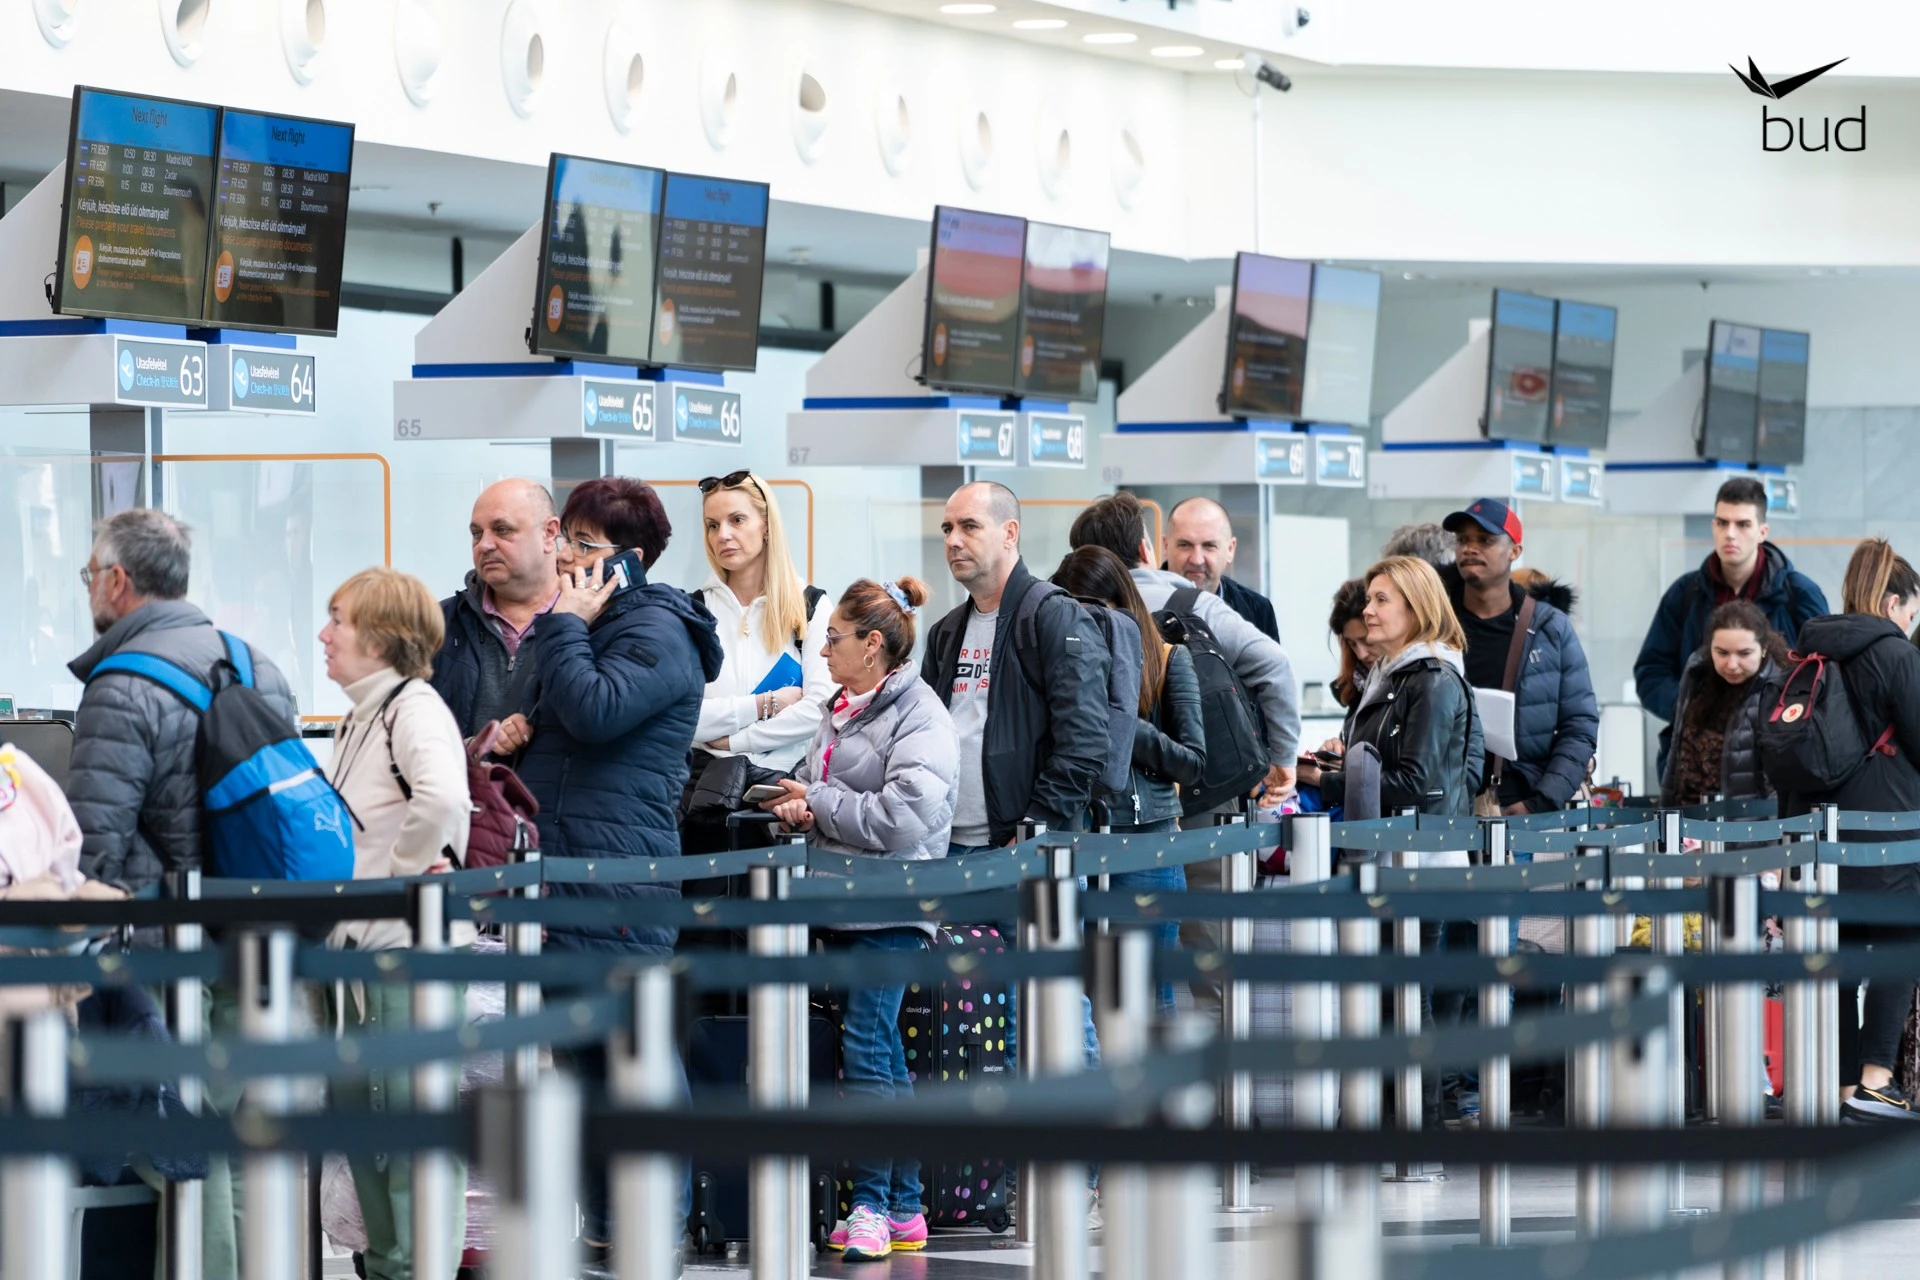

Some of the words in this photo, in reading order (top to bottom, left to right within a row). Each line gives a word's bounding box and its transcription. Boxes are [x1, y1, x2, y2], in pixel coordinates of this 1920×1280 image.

[132, 107, 148, 124] Next
[149, 109, 167, 128] flight
[272, 126, 287, 141] Next
[288, 128, 305, 147] flight
[166, 154, 181, 165] Madrid
[165, 170, 177, 179] Zadar
[163, 185, 192, 197] Bournemouth
[302, 186, 314, 196] Zadar
[77, 216, 94, 229] Please
[117, 223, 129, 234] your
[130, 223, 146, 234] travel
[146, 225, 175, 238] documents
[136, 357, 167, 371] Utasfelvétel
[180, 355, 203, 396] 63
[137, 375, 159, 387] Check-in
[250, 365, 279, 379] Utasfelvétel
[291, 363, 313, 404] 64
[251, 382, 272, 395] Check-in
[632, 392, 652, 431] 65
[721, 400, 740, 437] 66
[397, 419, 421, 437] 65
[998, 422, 1013, 457] 67
[1067, 425, 1083, 459] 68
[789, 447, 810, 464] 67
[1347, 445, 1361, 478] 70
